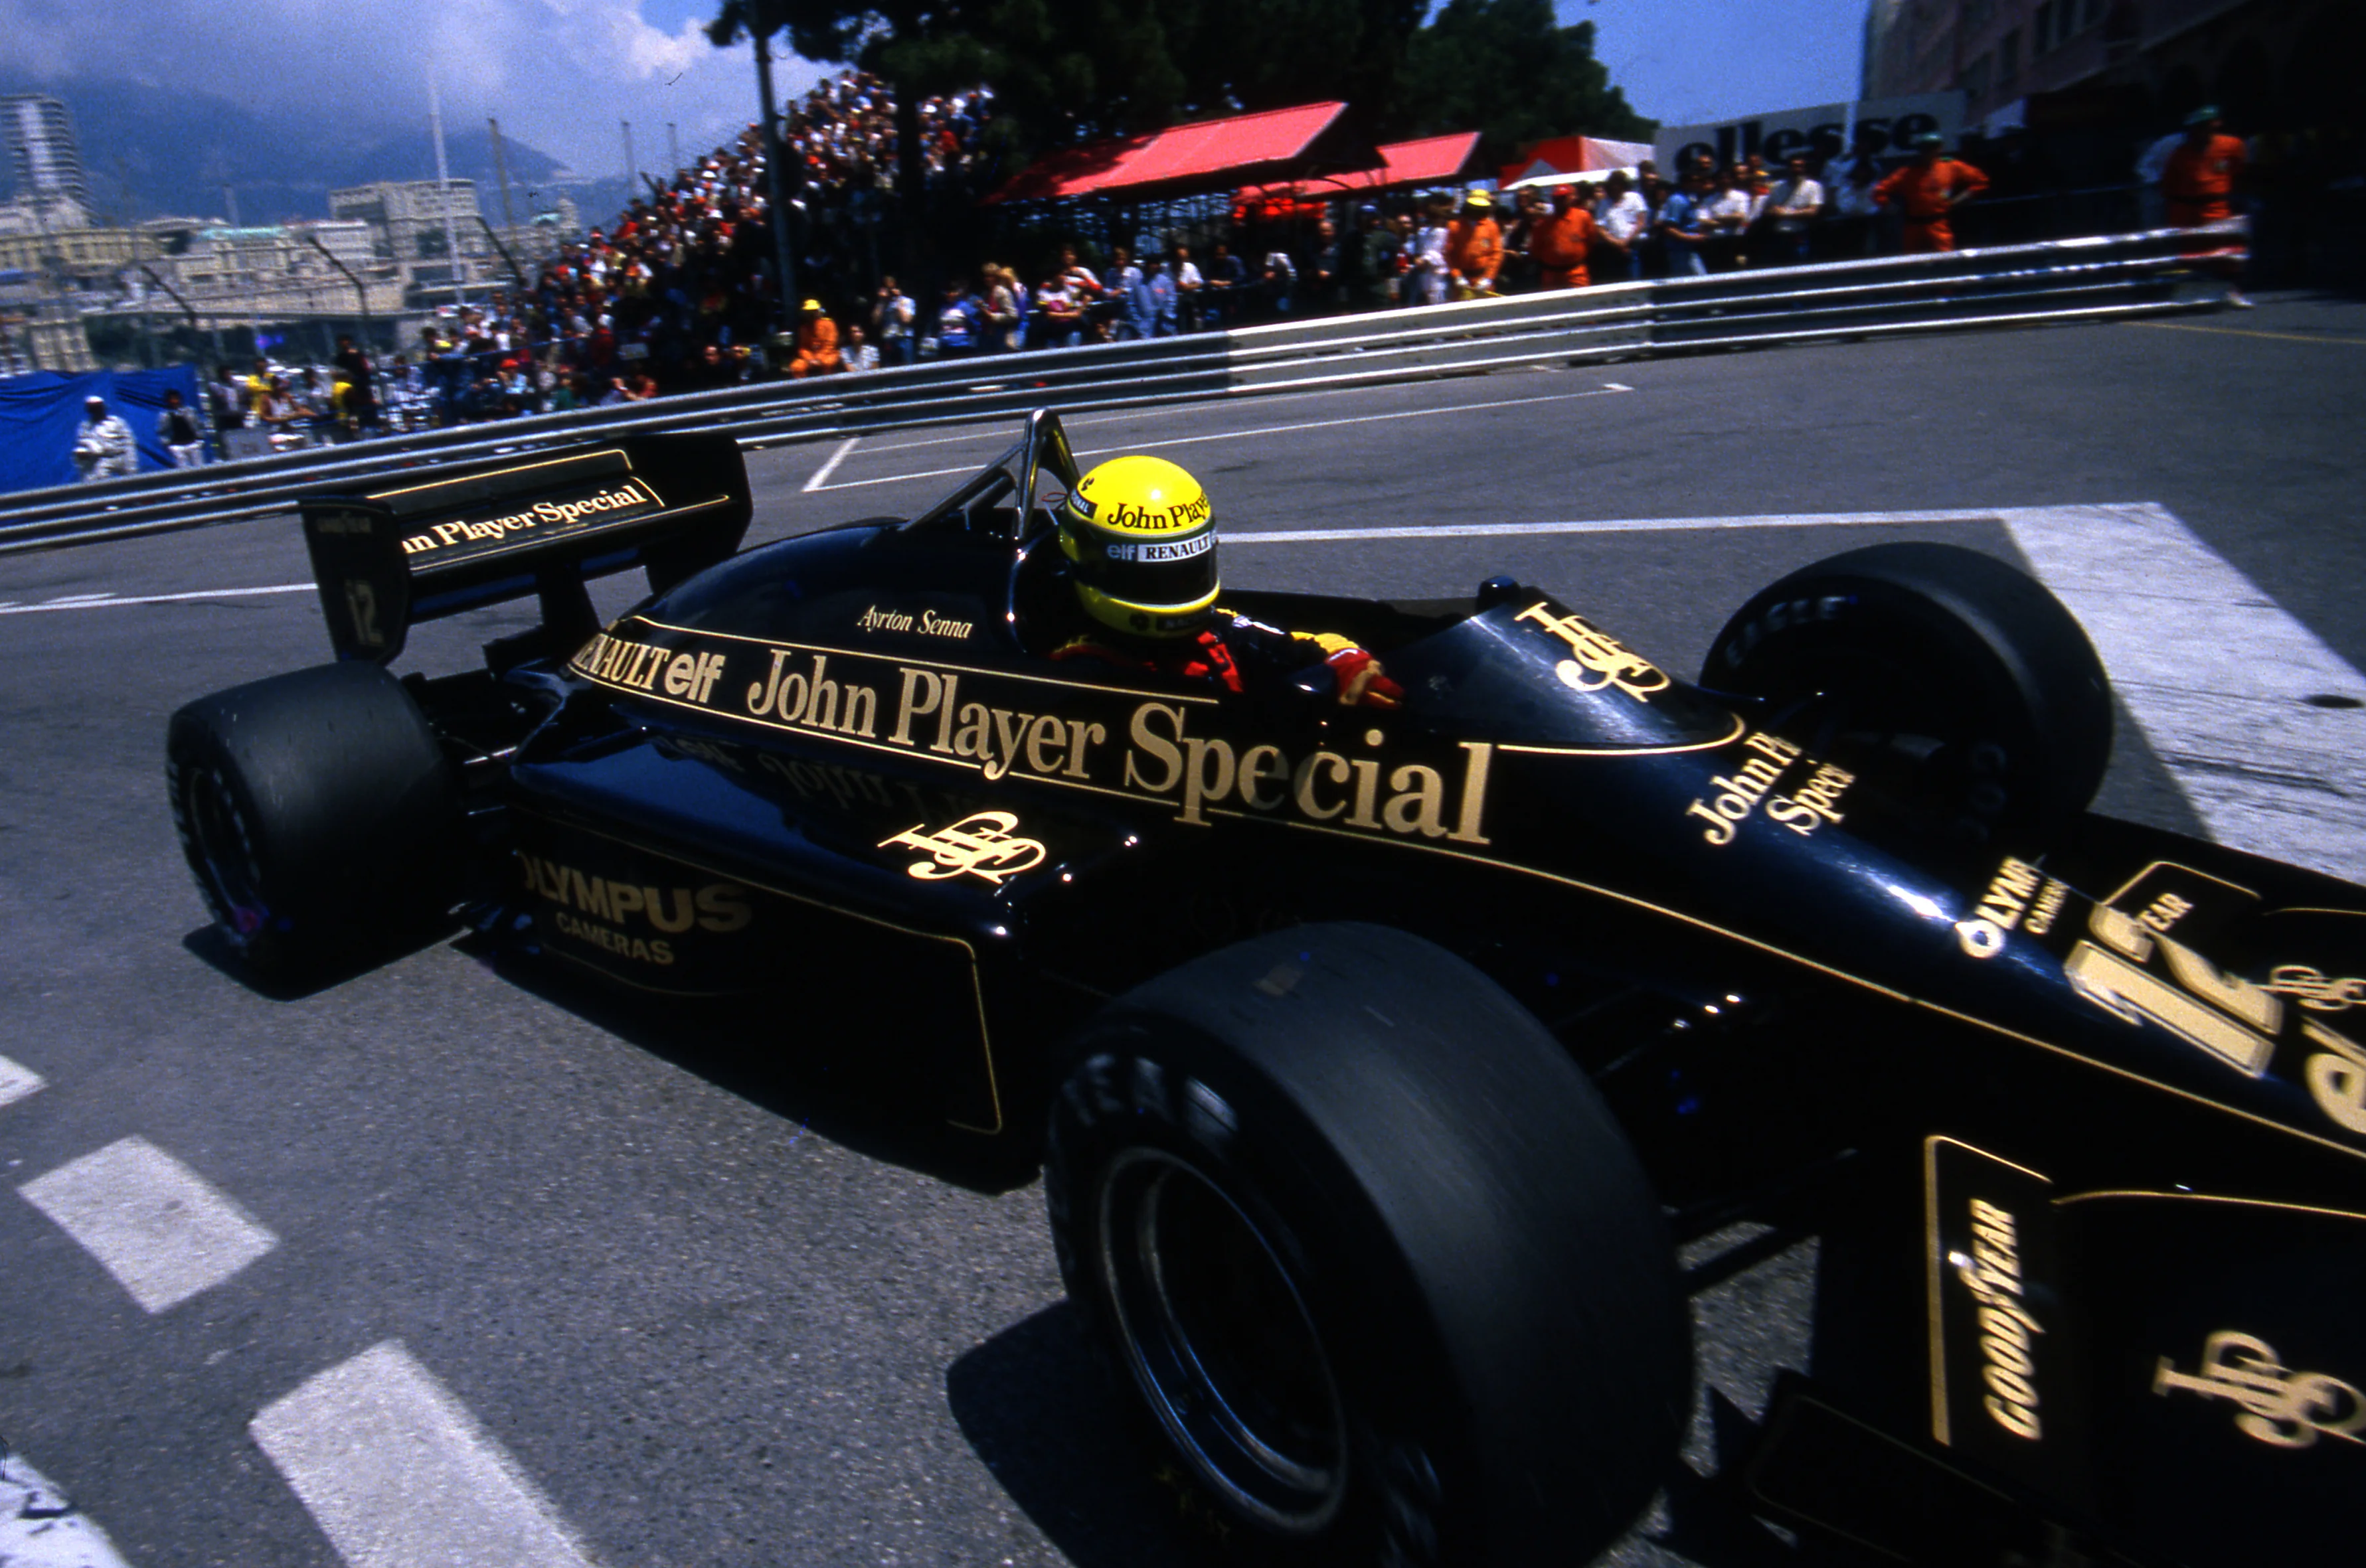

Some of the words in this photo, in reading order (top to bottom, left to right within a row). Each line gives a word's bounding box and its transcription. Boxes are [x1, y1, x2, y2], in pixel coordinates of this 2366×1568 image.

[432, 512, 537, 545] Player
[533, 486, 647, 523] Special
[1108, 502, 1169, 529] John
[1107, 543, 1136, 561] elf
[1145, 535, 1210, 560] RENAULT
[858, 604, 913, 633] Ayrton
[918, 609, 972, 639] Senna
[665, 651, 726, 704] elf
[748, 648, 877, 739] John
[888, 666, 1106, 780] Player
[1125, 702, 1491, 844] Special
[1686, 758, 1784, 844] John
[556, 911, 675, 966] CAMERAS
